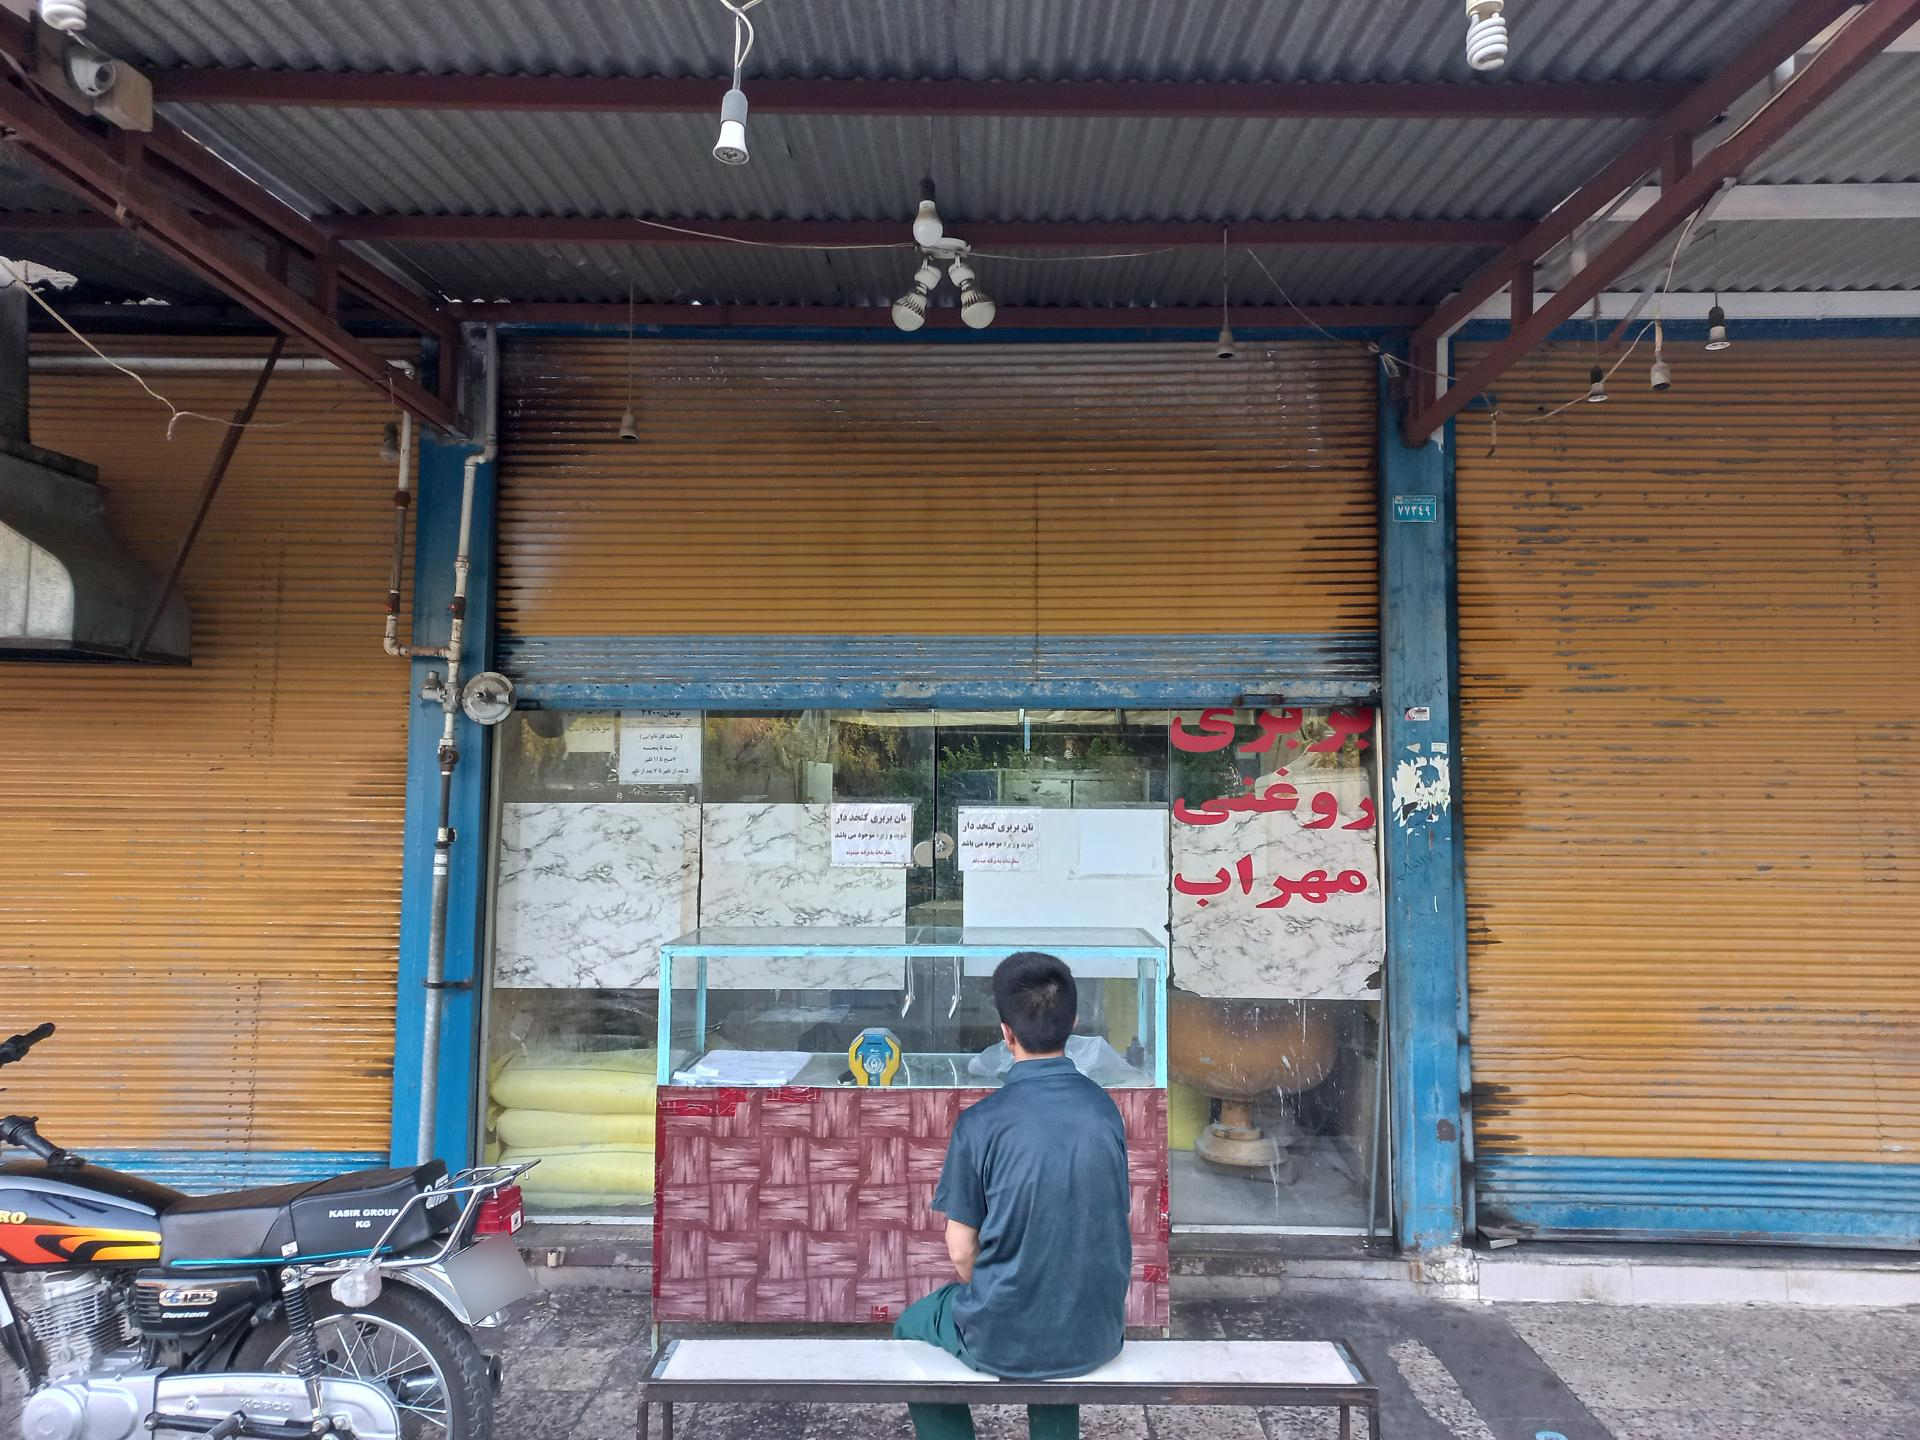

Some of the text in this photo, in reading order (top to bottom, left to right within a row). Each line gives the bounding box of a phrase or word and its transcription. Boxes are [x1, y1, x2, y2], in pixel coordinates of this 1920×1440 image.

[1171, 707, 1374, 753] بربری
[1173, 766, 1376, 830] روغنی
[835, 812, 907, 824] نان بربری کنجد دار
[962, 821, 1034, 833] نان بربری کنجد دار
[858, 832, 875, 840] موجود
[984, 840, 1002, 849] موجود
[1173, 853, 1368, 909] مهراب
[328, 1208, 399, 1218] KASIR GROUP
[355, 1220, 371, 1228] KG
